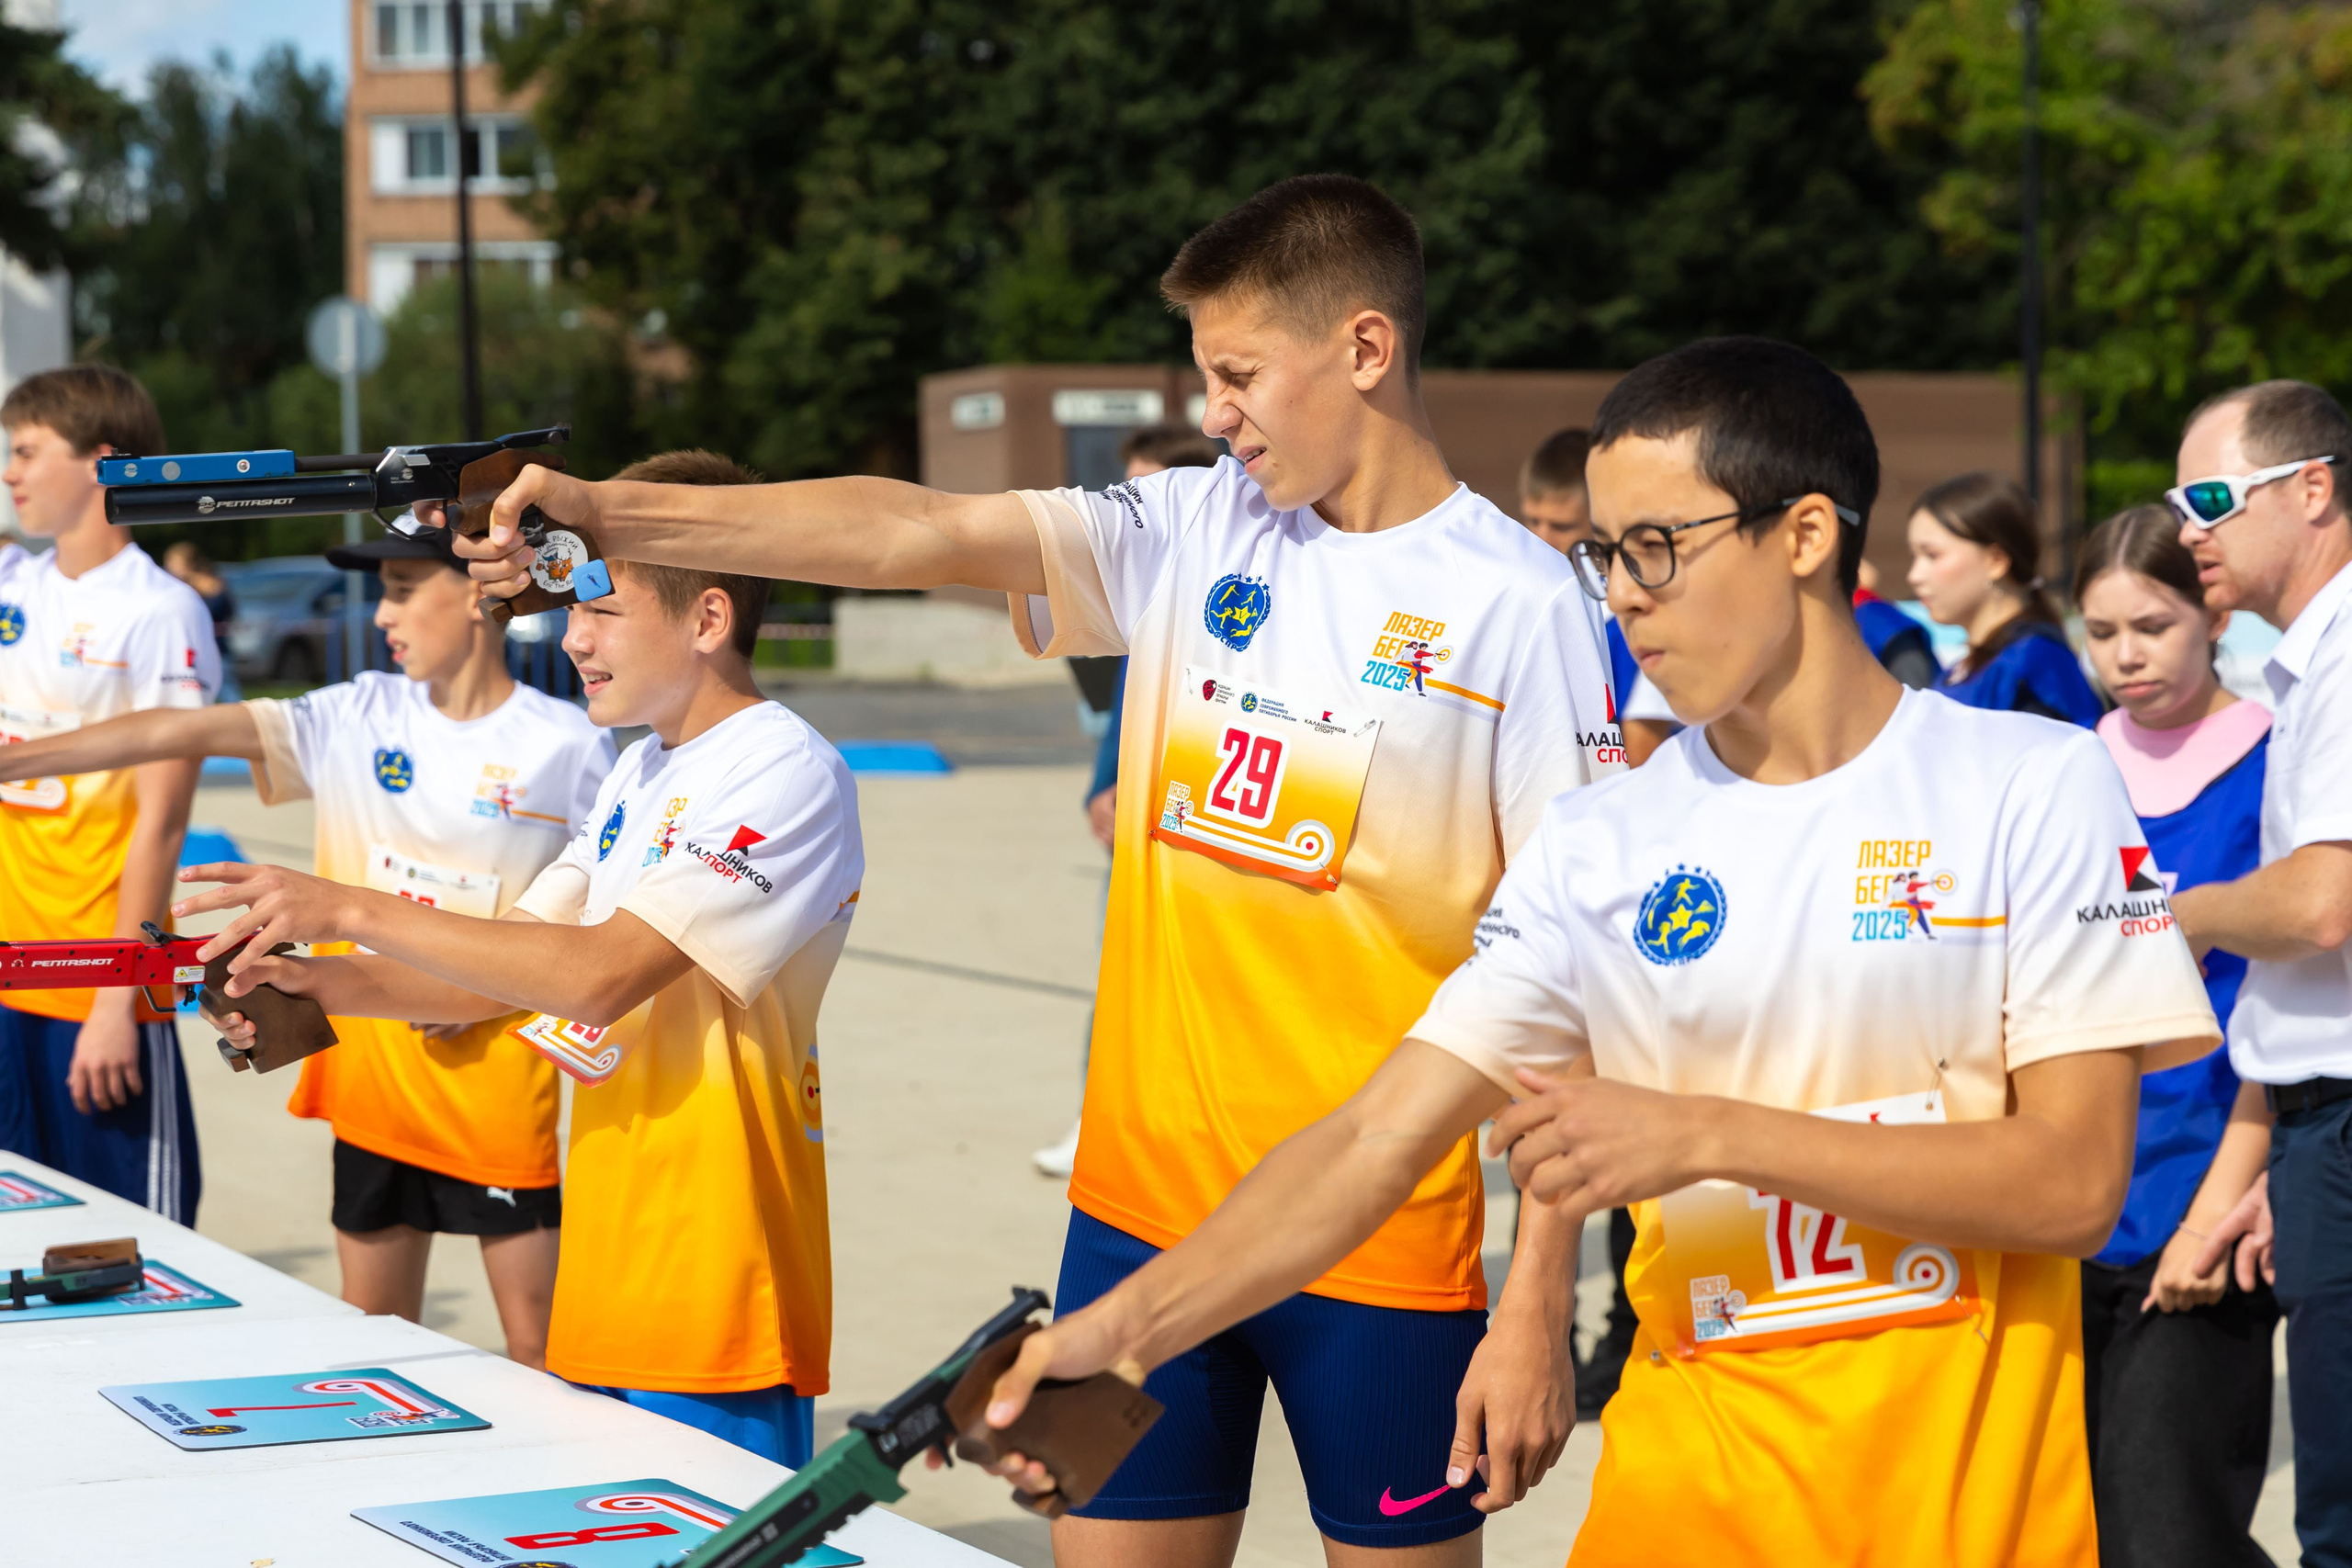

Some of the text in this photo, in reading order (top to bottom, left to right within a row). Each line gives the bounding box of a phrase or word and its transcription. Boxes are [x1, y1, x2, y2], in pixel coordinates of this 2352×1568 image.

[216, 497, 296, 508] PENTASHOT
[1383, 611, 1446, 642] ЛАЗЕР
[1213, 630, 1238, 649] ФСПР
[1372, 635, 1411, 660] БЕГ
[1360, 660, 1410, 692] 2025
[1304, 718, 1347, 734] КАЛАШНИКОВ
[1314, 727, 1334, 736] СПОРТ
[1211, 728, 1283, 819] 29
[1169, 782, 1190, 800] ЛАЗЕР
[1160, 813, 1179, 830] 2025
[1857, 840, 1931, 869] ЛАЗЕР
[1856, 874, 1894, 905] БЕГ
[2076, 897, 2168, 923] КАЛАШН
[1852, 909, 1907, 942] 2025
[2120, 915, 2174, 937] СПОР
[31, 958, 115, 967] PENTASHOT
[1696, 1319, 1725, 1339] 2025
[503, 1521, 681, 1550] 8
